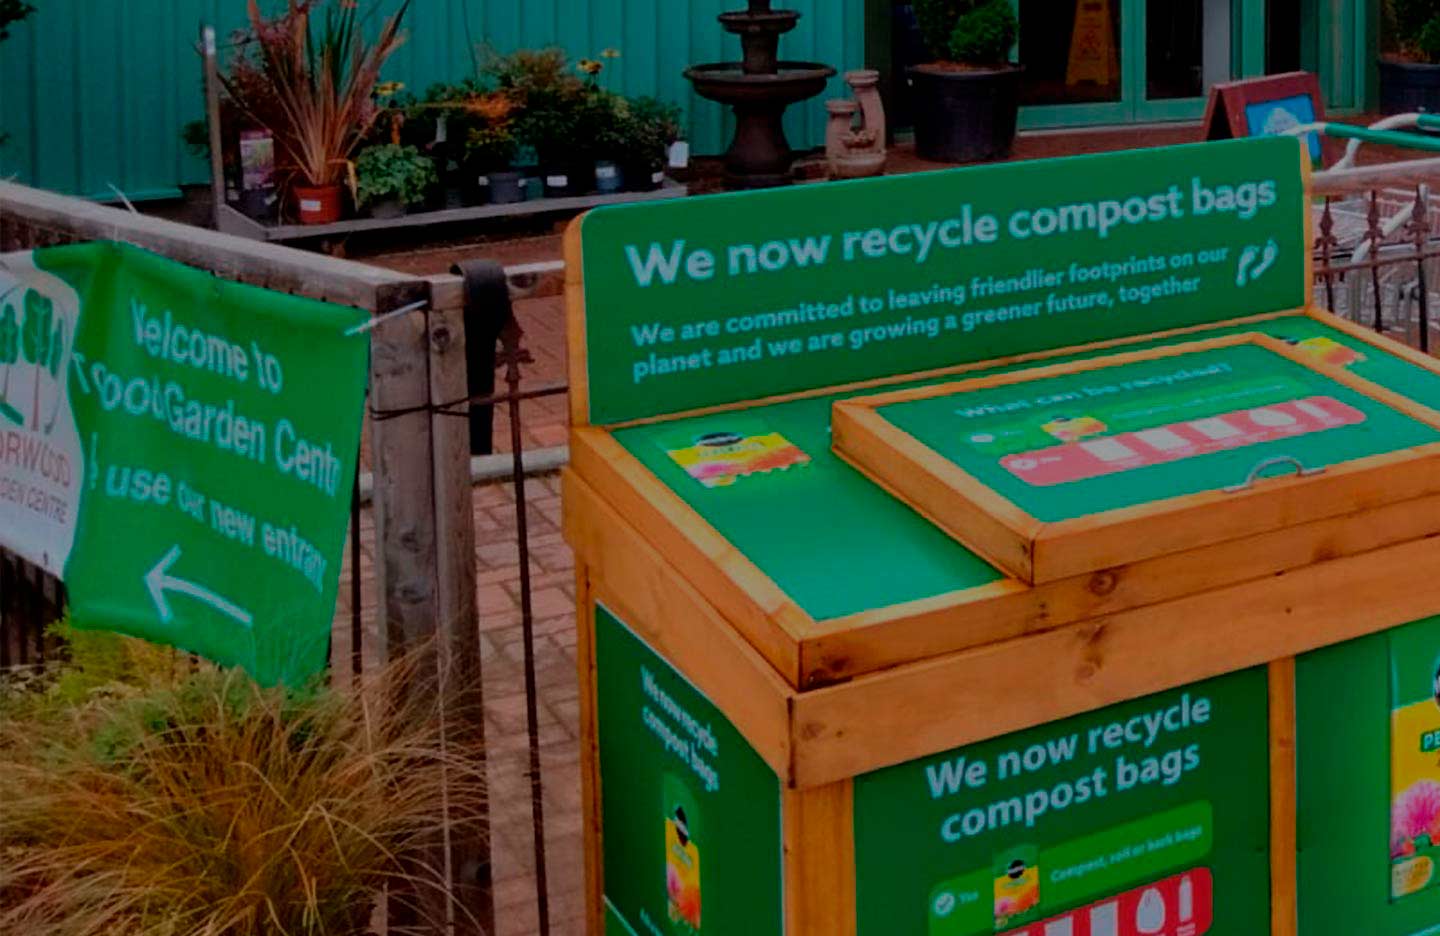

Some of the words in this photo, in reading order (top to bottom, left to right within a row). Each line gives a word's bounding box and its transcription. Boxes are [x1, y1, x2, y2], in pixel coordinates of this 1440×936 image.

[624, 238, 715, 288] We
[727, 234, 833, 276] now
[842, 203, 999, 264] recycle
[1008, 184, 1185, 238] compost
[1191, 176, 1277, 219] bags
[630, 322, 676, 347] We
[680, 319, 721, 341] are
[725, 294, 854, 334] committed
[859, 295, 884, 314] to
[888, 283, 966, 311] leaving
[971, 268, 1065, 298] friendlier
[1068, 255, 1167, 284] footprints
[1170, 251, 1194, 269] on
[1197, 246, 1229, 264] our
[633, 348, 712, 384] planet
[717, 338, 762, 364] and
[767, 338, 803, 358] we
[807, 330, 845, 351] are
[849, 314, 940, 349] growing
[944, 314, 957, 330] a
[962, 299, 1043, 331] greener
[1046, 291, 1114, 315] future,
[1118, 275, 1201, 305] together
[253, 340, 283, 394] to
[164, 380, 265, 463] Garden
[105, 463, 171, 505] use
[210, 498, 256, 546] new
[925, 756, 988, 799] We
[997, 733, 1079, 781] now
[1088, 692, 1212, 753] recycle
[941, 767, 1108, 843] compost
[1116, 743, 1200, 792] bags
